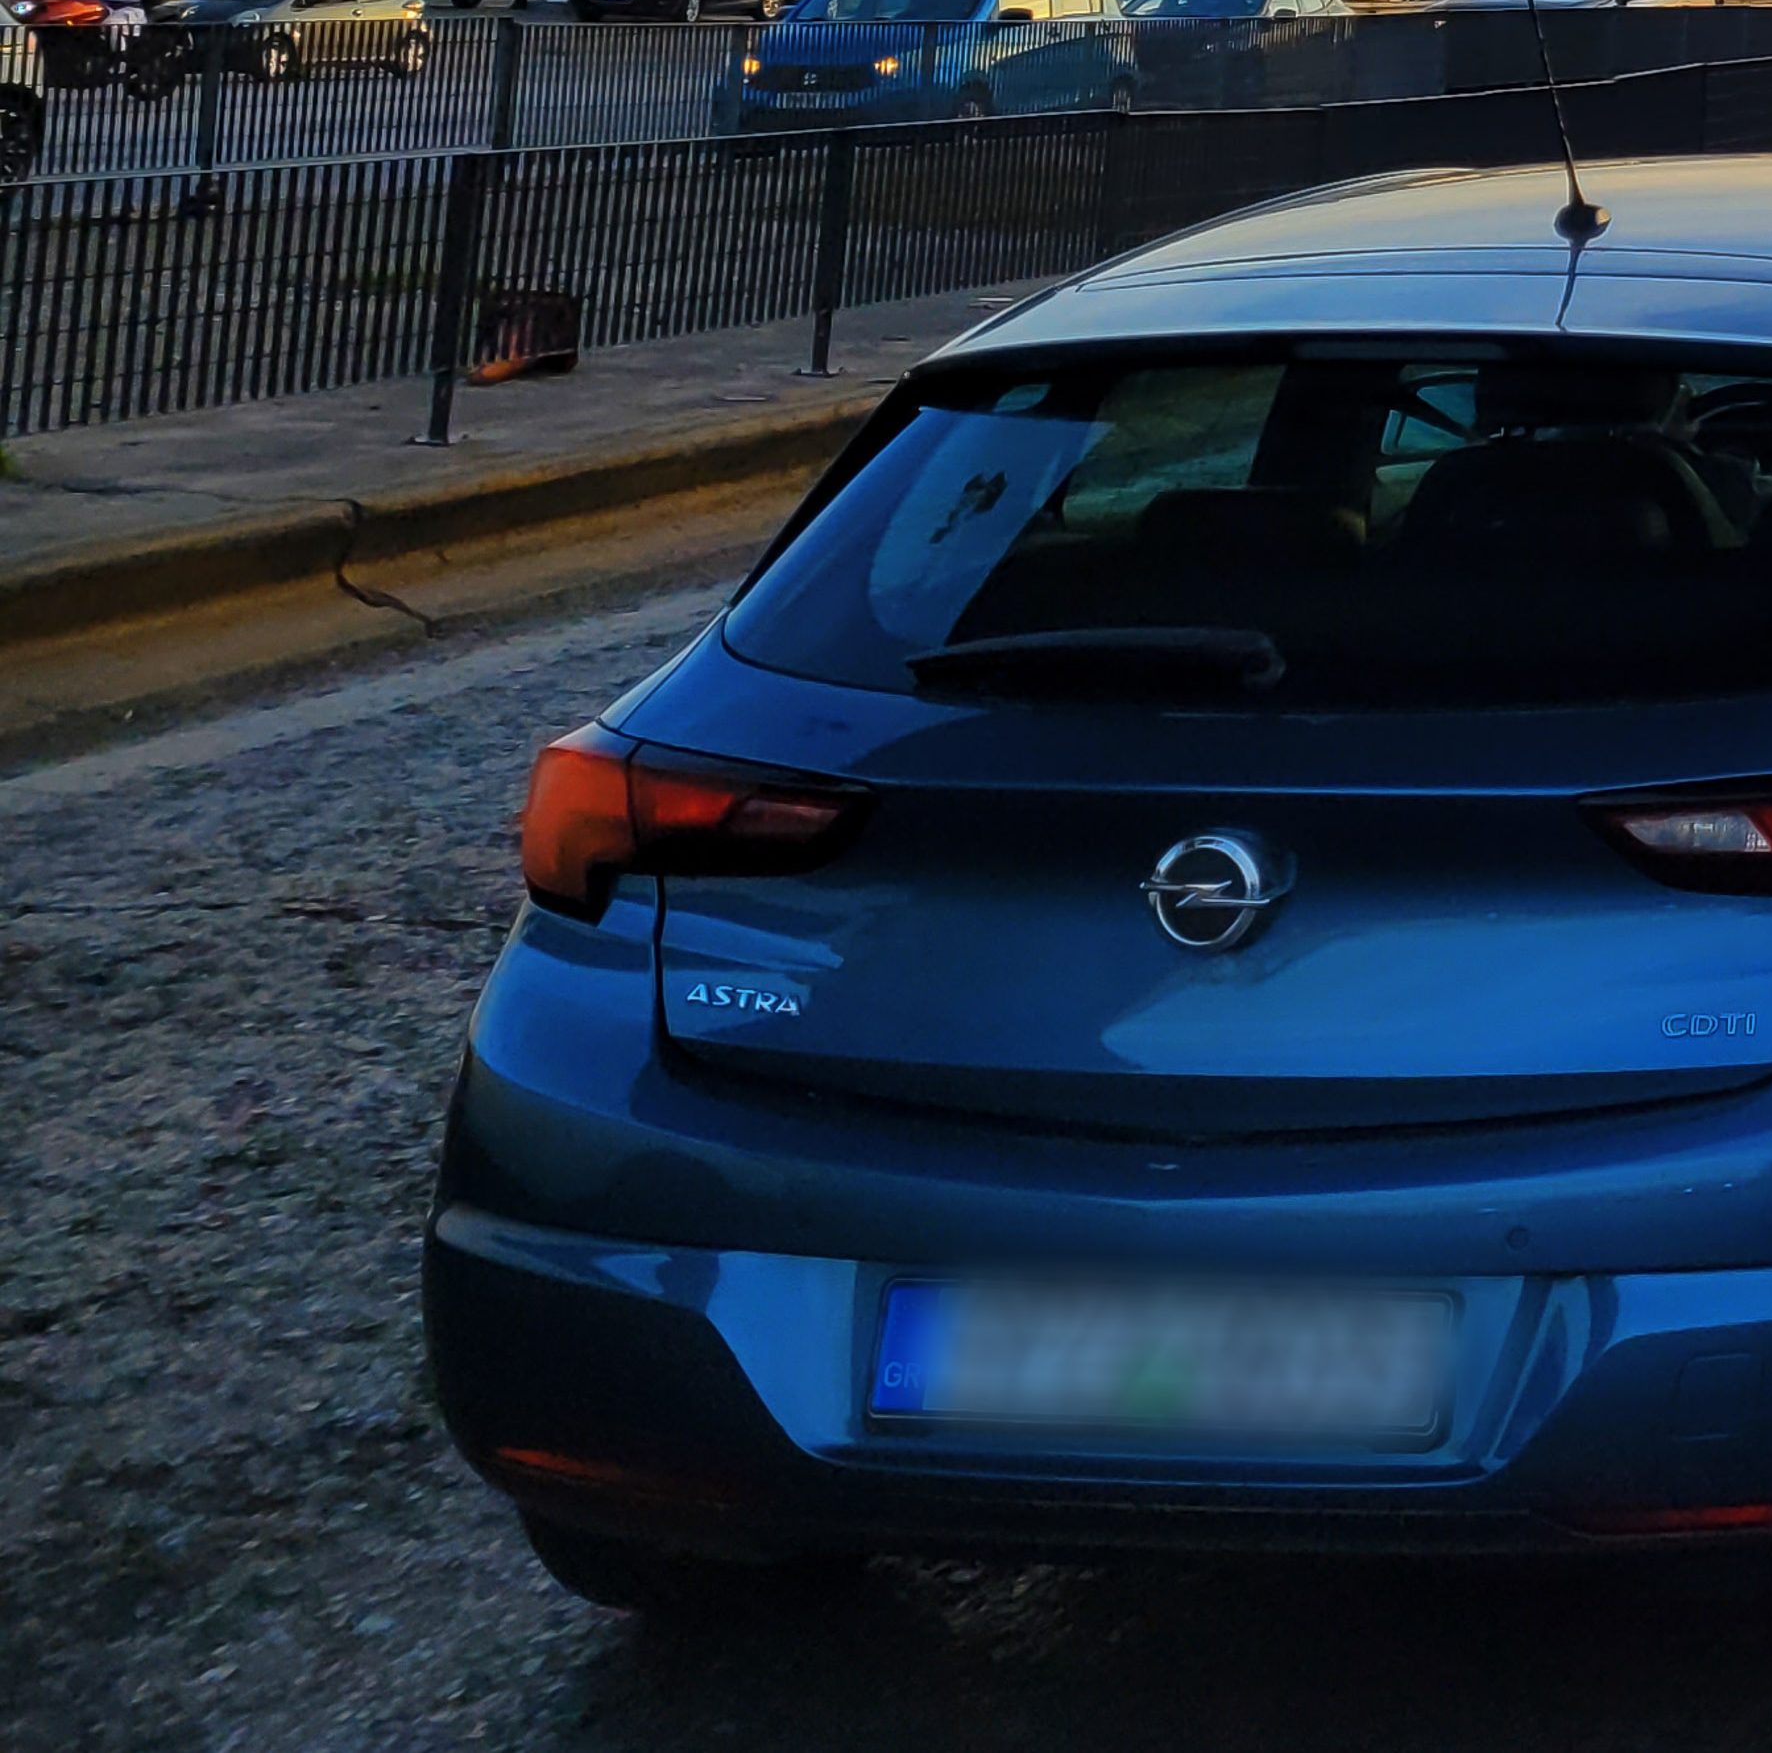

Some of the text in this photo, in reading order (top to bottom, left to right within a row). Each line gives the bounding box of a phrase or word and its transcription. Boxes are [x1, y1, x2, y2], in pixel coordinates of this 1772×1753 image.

[686, 983, 800, 1016] ASTRA
[1662, 1012, 1756, 1037] CDTI
[882, 1361, 921, 1389] GR
